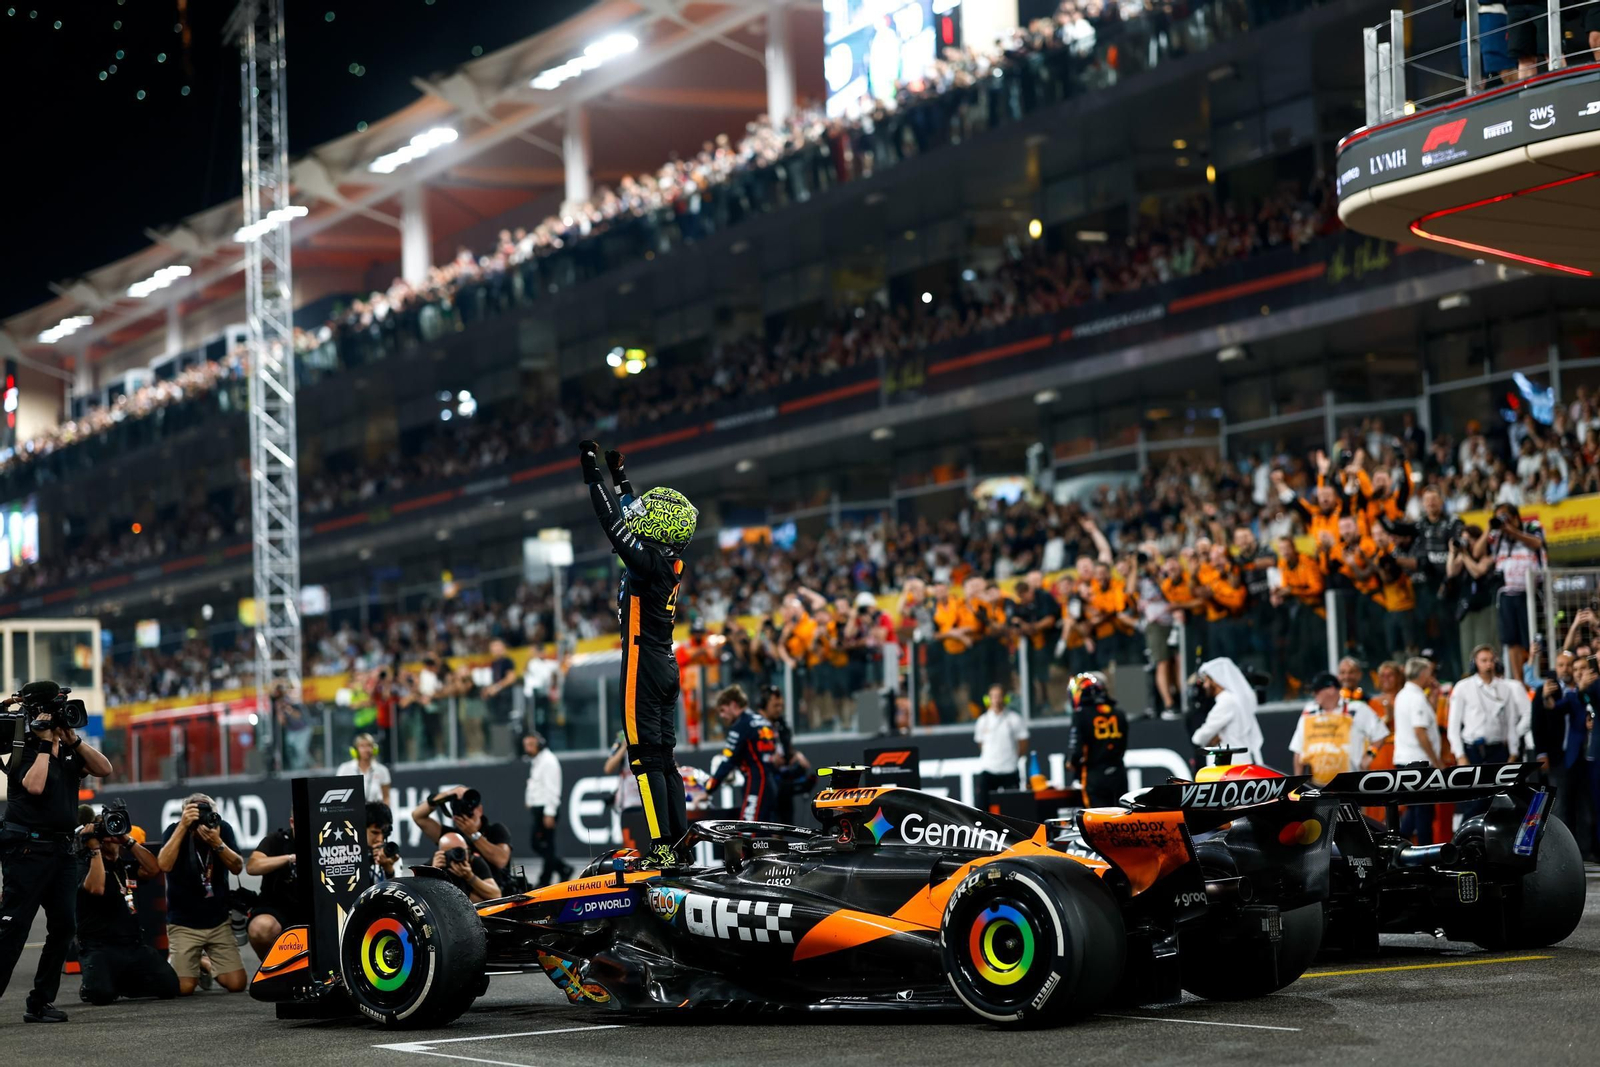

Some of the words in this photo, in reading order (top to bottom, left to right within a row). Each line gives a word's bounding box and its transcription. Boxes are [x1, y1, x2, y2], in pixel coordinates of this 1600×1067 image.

[1529, 104, 1555, 122] aws
[1483, 120, 1513, 139] PIRELLI
[1369, 148, 1407, 175] LVMH
[1093, 715, 1123, 739] 81
[1358, 763, 1522, 793] ORACLE
[1180, 778, 1287, 808] VELO.COM
[900, 813, 1010, 852] Gemini
[1103, 819, 1167, 834] Dropbox
[318, 844, 361, 858] WORLD
[752, 841, 769, 849] okta
[1110, 836, 1148, 848] Dash
[325, 864, 356, 877] 2025
[567, 881, 602, 892] RICHARD
[382, 887, 425, 917] ZERO
[585, 902, 598, 912] DP
[599, 898, 632, 910] WORLD
[943, 873, 981, 927] ZERO
[1181, 891, 1208, 907] groq
[278, 942, 304, 951] workday
[1031, 971, 1061, 1011] PIRELLI
